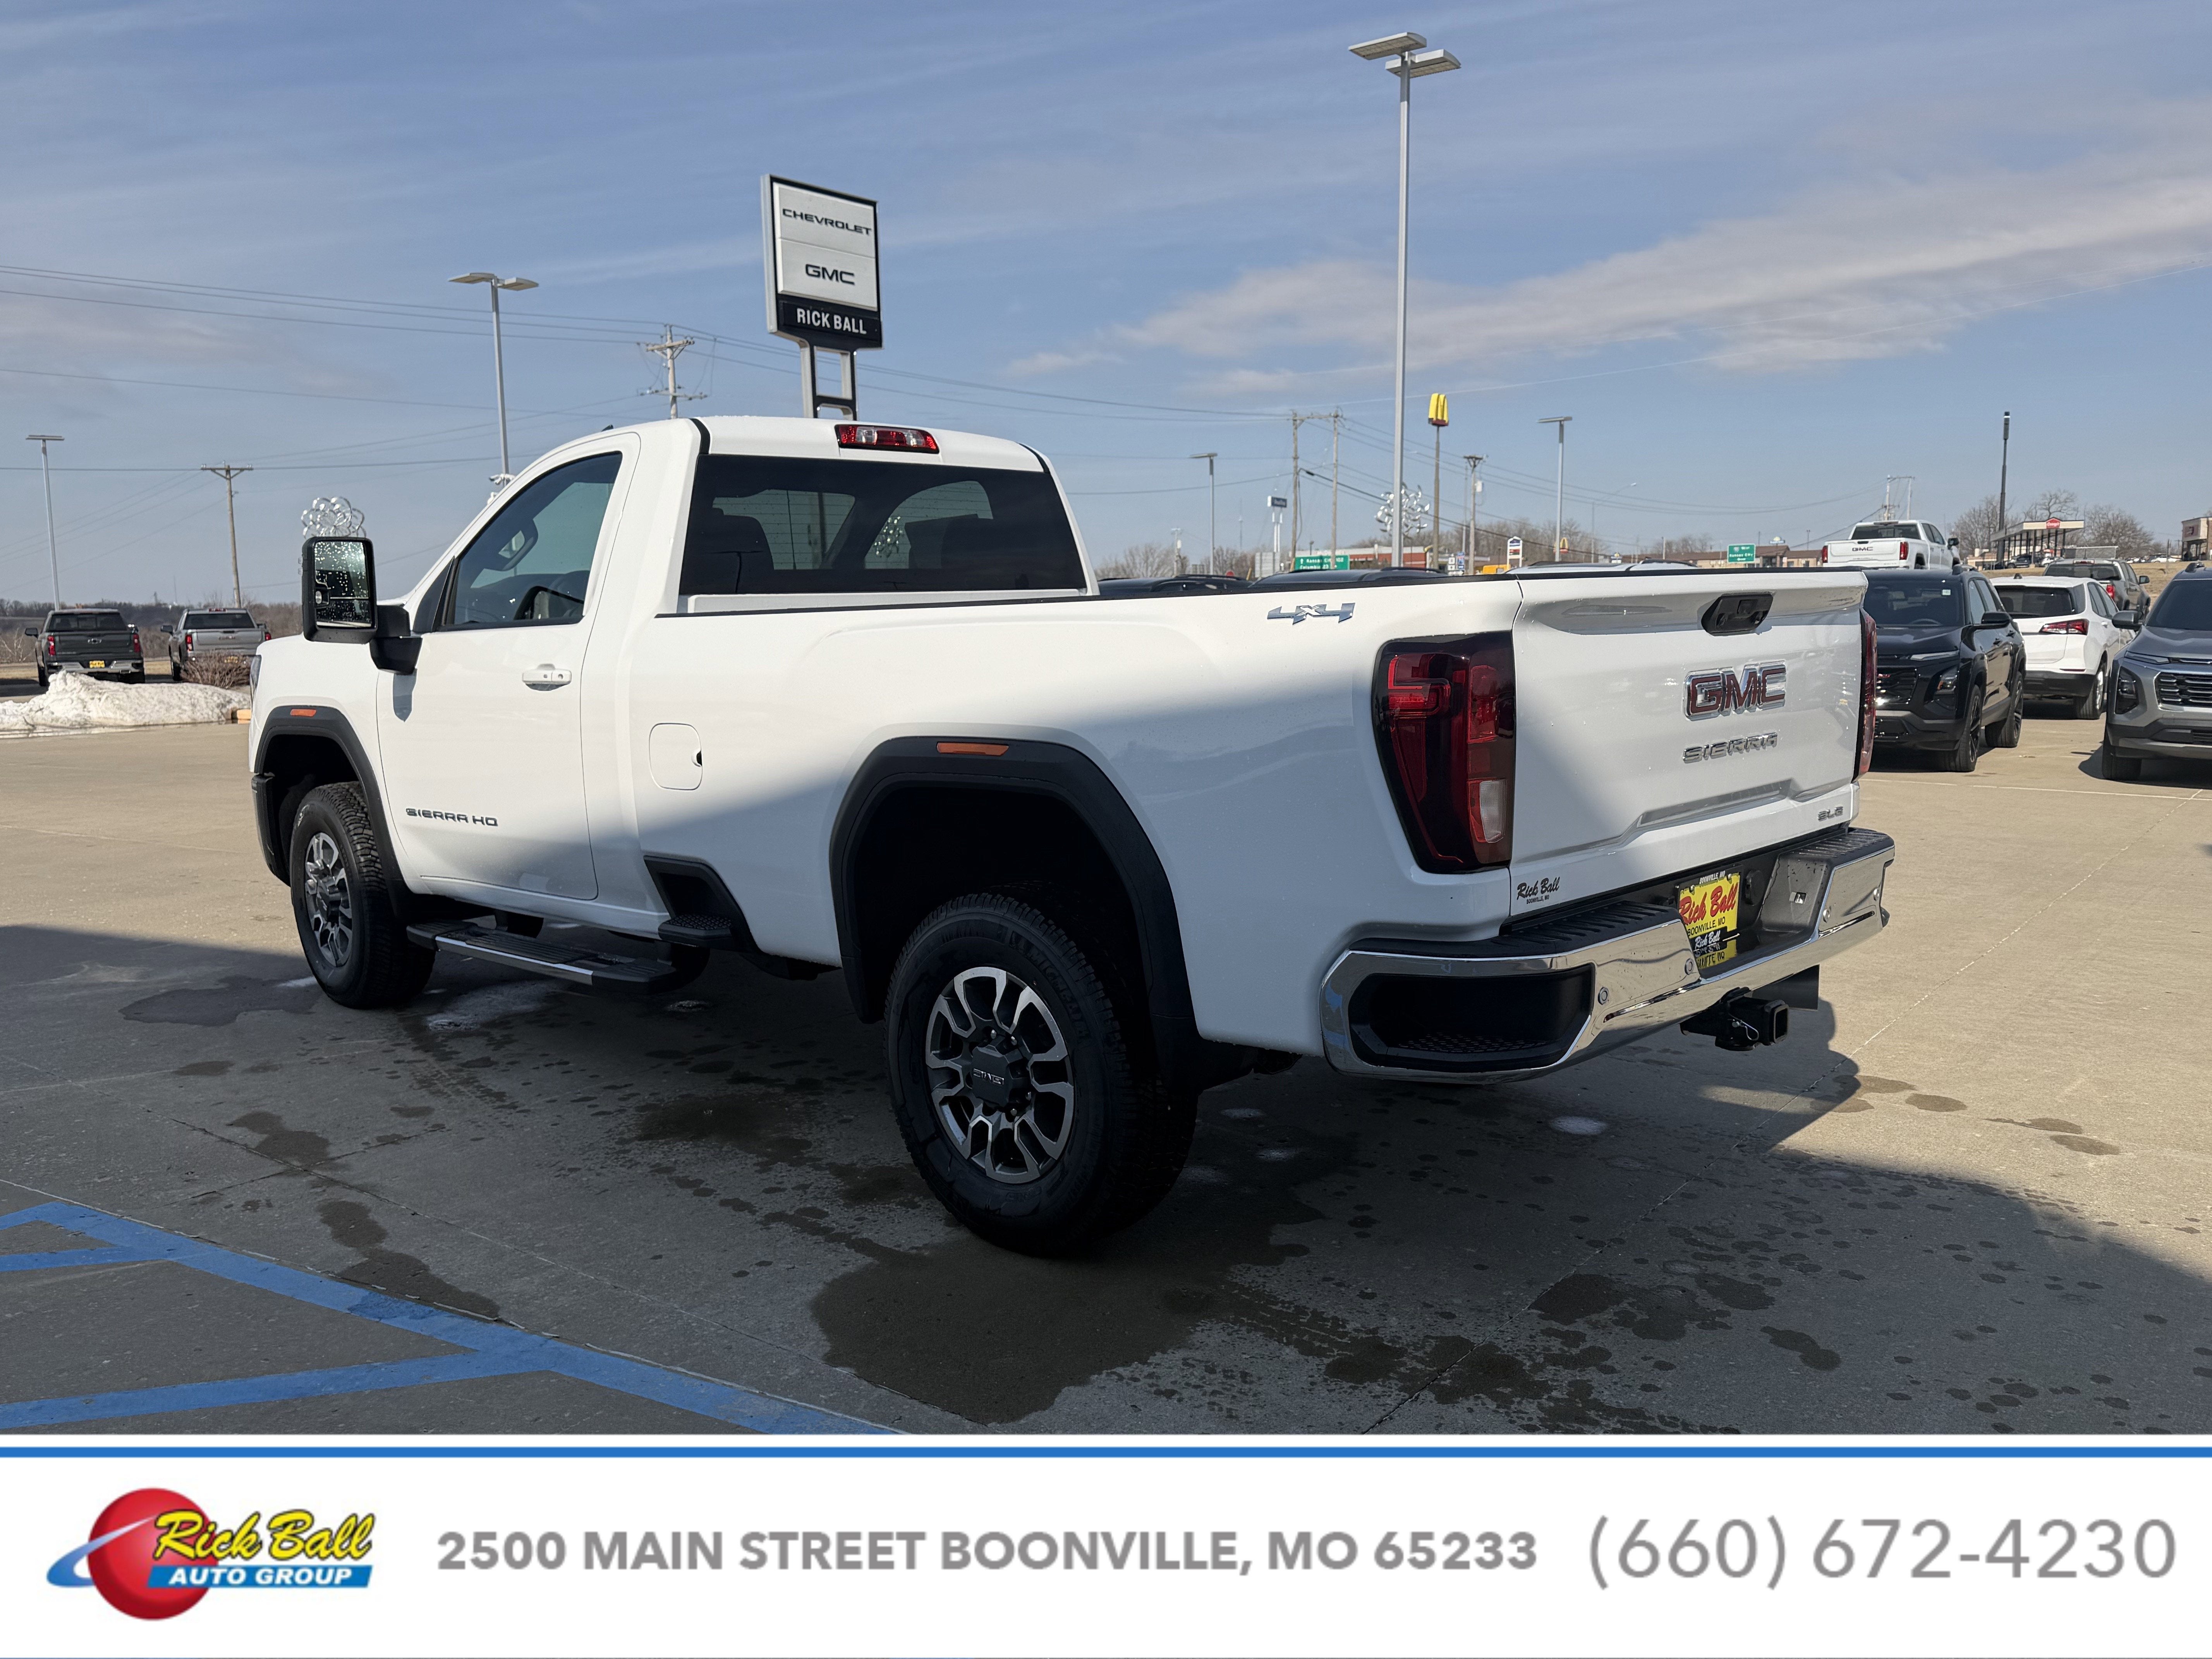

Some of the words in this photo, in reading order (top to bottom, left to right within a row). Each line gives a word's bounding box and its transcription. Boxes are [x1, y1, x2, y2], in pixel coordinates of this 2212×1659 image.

[782, 208, 871, 235] CHEVROLET
[805, 264, 855, 285] GMC
[796, 308, 830, 328] RICK
[833, 314, 867, 334] BALL
[1682, 659, 1786, 721] GMC
[1682, 732, 1778, 764] SIERRA
[405, 808, 469, 823] SIERRA
[472, 816, 498, 827] HD
[1516, 880, 1539, 900] Rick
[1540, 876, 1560, 894] Ball
[1679, 892, 1707, 925] Rick
[1710, 883, 1738, 917] Ball
[1718, 916, 1726, 926] MO
[1695, 934, 1707, 950] Rick
[1708, 930, 1721, 944] Ball
